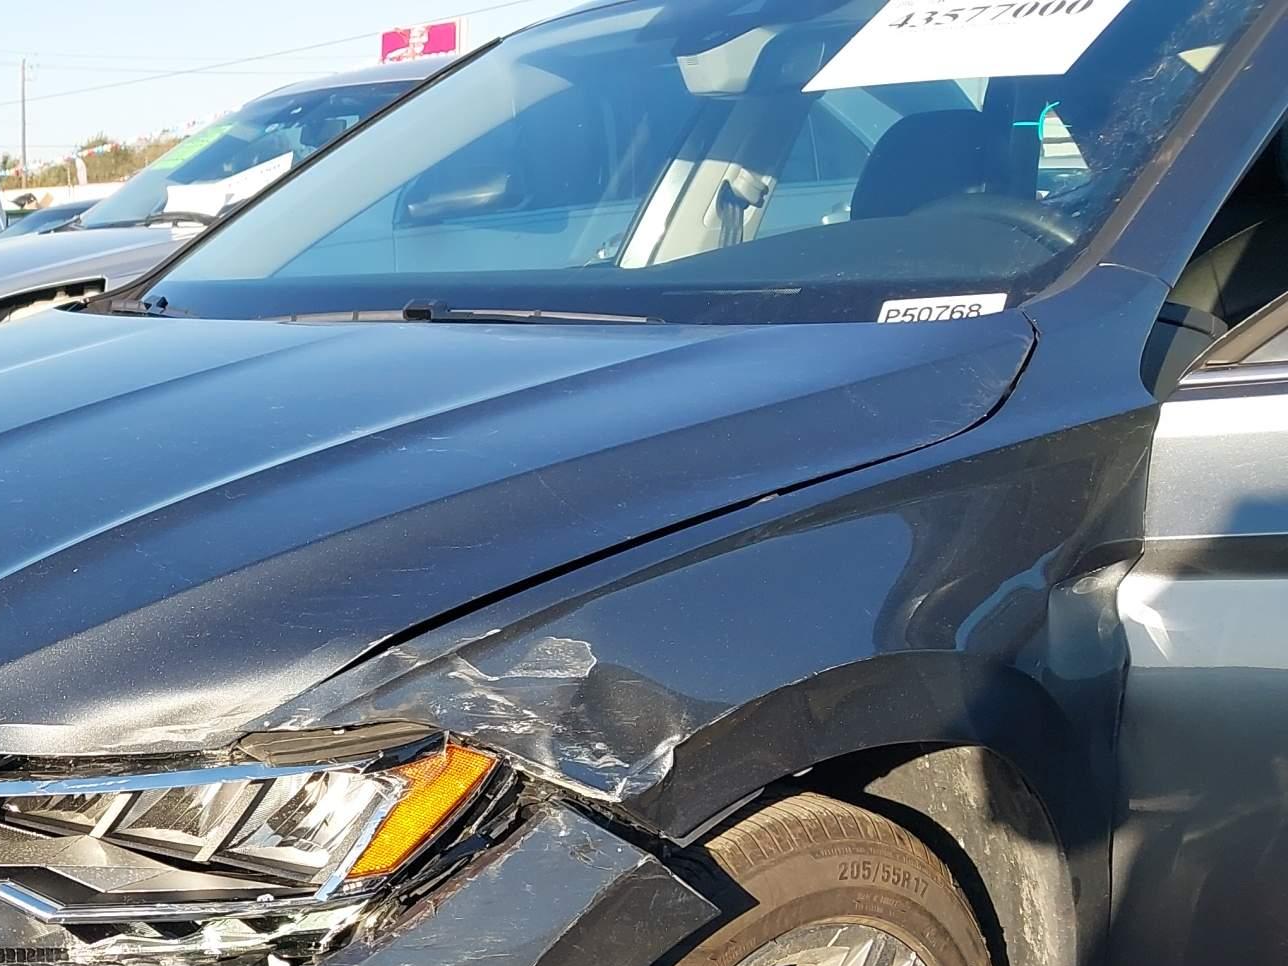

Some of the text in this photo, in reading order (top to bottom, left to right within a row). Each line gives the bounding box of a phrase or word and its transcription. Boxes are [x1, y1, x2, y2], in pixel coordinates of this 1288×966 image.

[887, 0, 1093, 28] 43577000
[885, 304, 982, 323] P50768
[838, 860, 929, 898] 205/55R17
